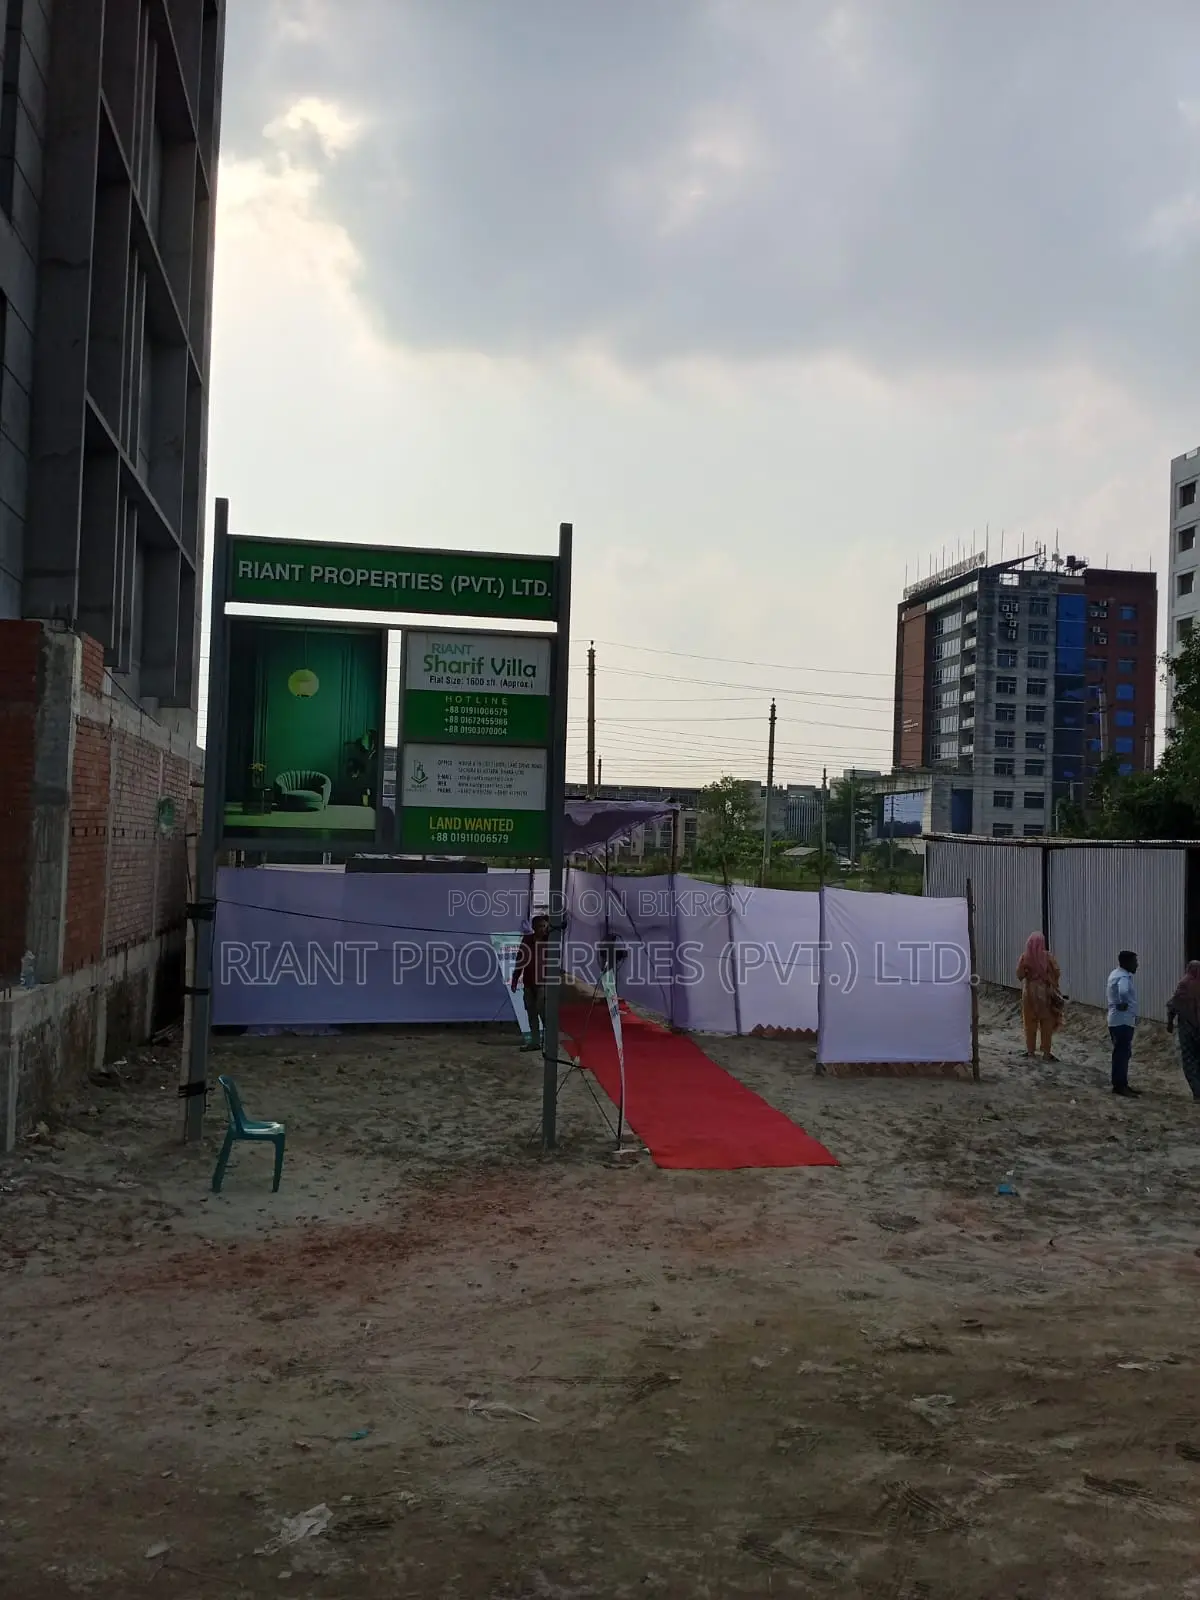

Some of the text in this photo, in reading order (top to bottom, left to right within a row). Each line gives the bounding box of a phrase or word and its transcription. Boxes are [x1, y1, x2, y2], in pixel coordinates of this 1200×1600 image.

[237, 559, 553, 599] RIANT PROPERTIES (PVT.) LTD.
[431, 643, 475, 656] RIANT
[423, 654, 537, 678] Sharif Villa
[429, 675, 444, 684] Flat
[446, 676, 464, 686] Size:
[466, 678, 485, 687] 1600
[445, 695, 509, 706] HOTLINE
[444, 706, 459, 714] +88
[444, 715, 459, 724] +88
[444, 725, 459, 733] +88
[429, 816, 514, 832] LAND WANTED
[431, 832, 509, 844] +88 01911006579
